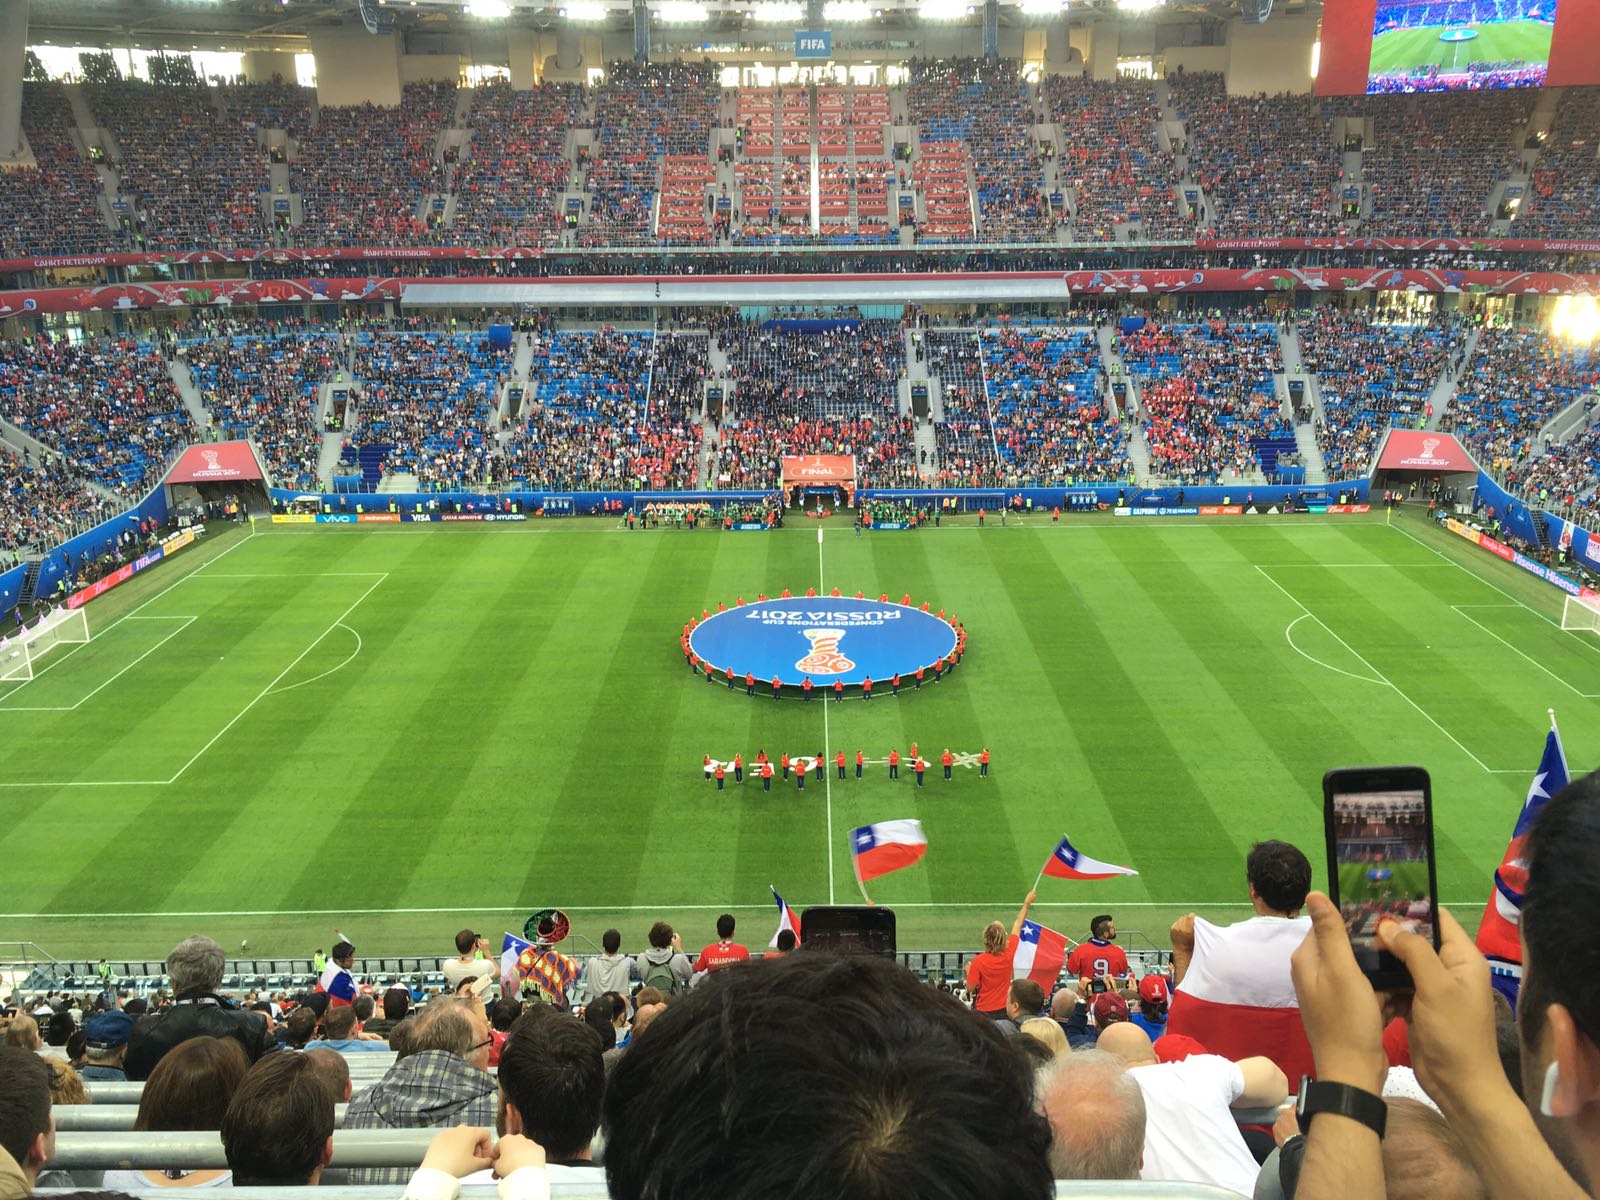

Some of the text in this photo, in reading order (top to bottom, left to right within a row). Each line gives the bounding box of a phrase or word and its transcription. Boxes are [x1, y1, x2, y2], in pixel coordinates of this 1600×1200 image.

[800, 39, 825, 50] FIFA
[34, 257, 107, 267] САНКТ-ПЕТЕРБУРГ
[801, 467, 834, 475] FINAL
[411, 514, 431, 522] VISA
[1513, 552, 1545, 577] Hisense
[1545, 568, 1580, 596] Hisense
[746, 609, 901, 621] RUSSIA 2017
[1093, 958, 1110, 978] 9
